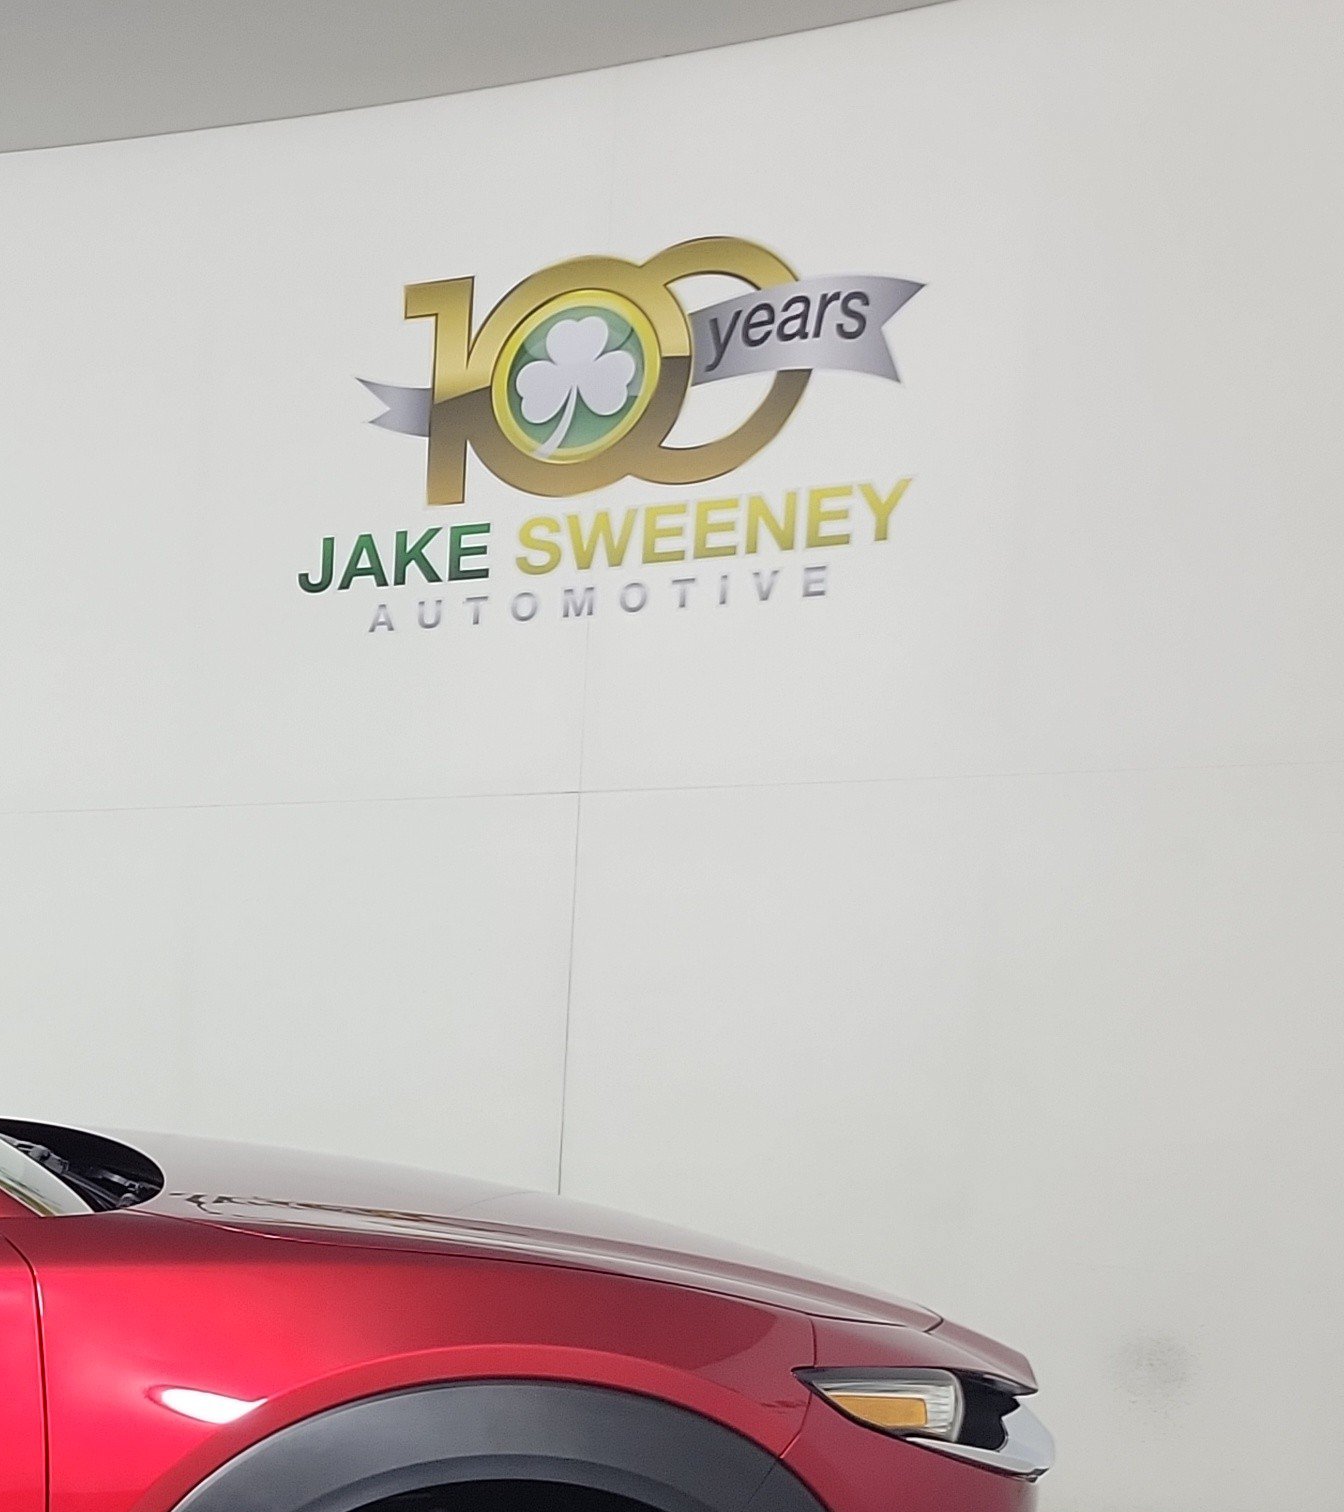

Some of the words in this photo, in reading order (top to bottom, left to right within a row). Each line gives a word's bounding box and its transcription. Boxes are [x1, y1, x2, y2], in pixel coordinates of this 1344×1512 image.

[404, 235, 814, 506] 100
[704, 288, 870, 371] years
[297, 522, 492, 594] JAKE
[515, 478, 913, 576] SWEENEY
[368, 564, 829, 634] AUTOMOTIVE
